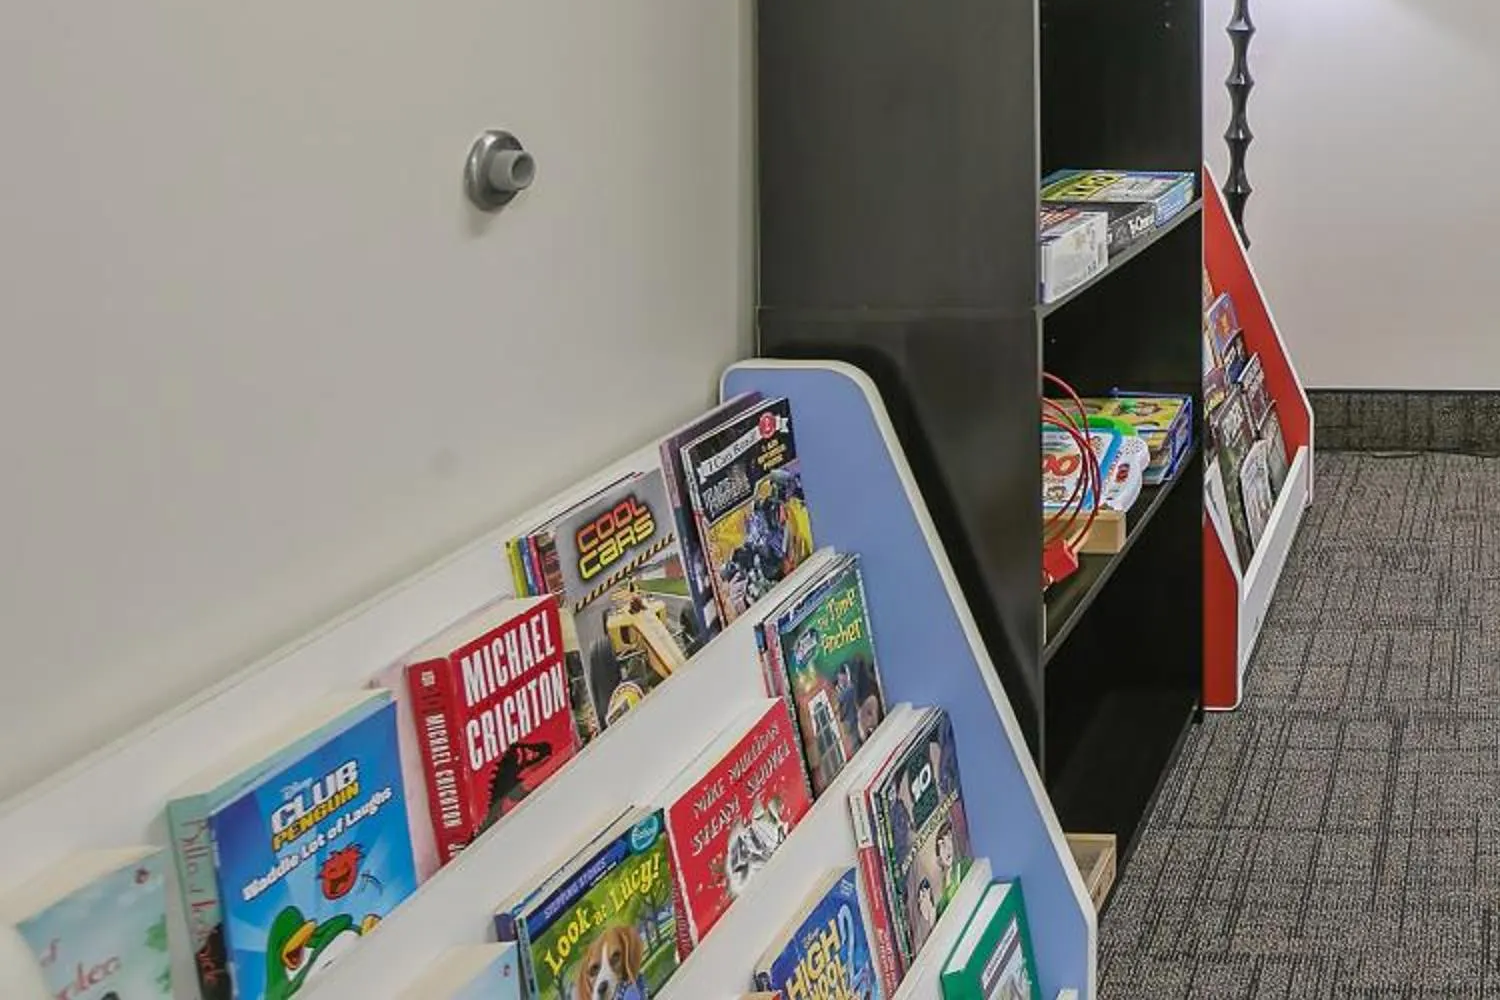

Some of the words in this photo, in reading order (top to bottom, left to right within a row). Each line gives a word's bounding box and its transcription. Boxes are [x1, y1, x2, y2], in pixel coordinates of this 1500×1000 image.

[576, 494, 647, 553] COOL
[460, 609, 556, 708] MICHAEL
[465, 661, 566, 772] CRICHTON
[271, 760, 360, 834] CLUB
[272, 782, 360, 852] PENGUIN
[327, 817, 344, 841] of
[544, 907, 592, 977] Look
[591, 904, 607, 925] at
[609, 852, 662, 912] Lucy!
